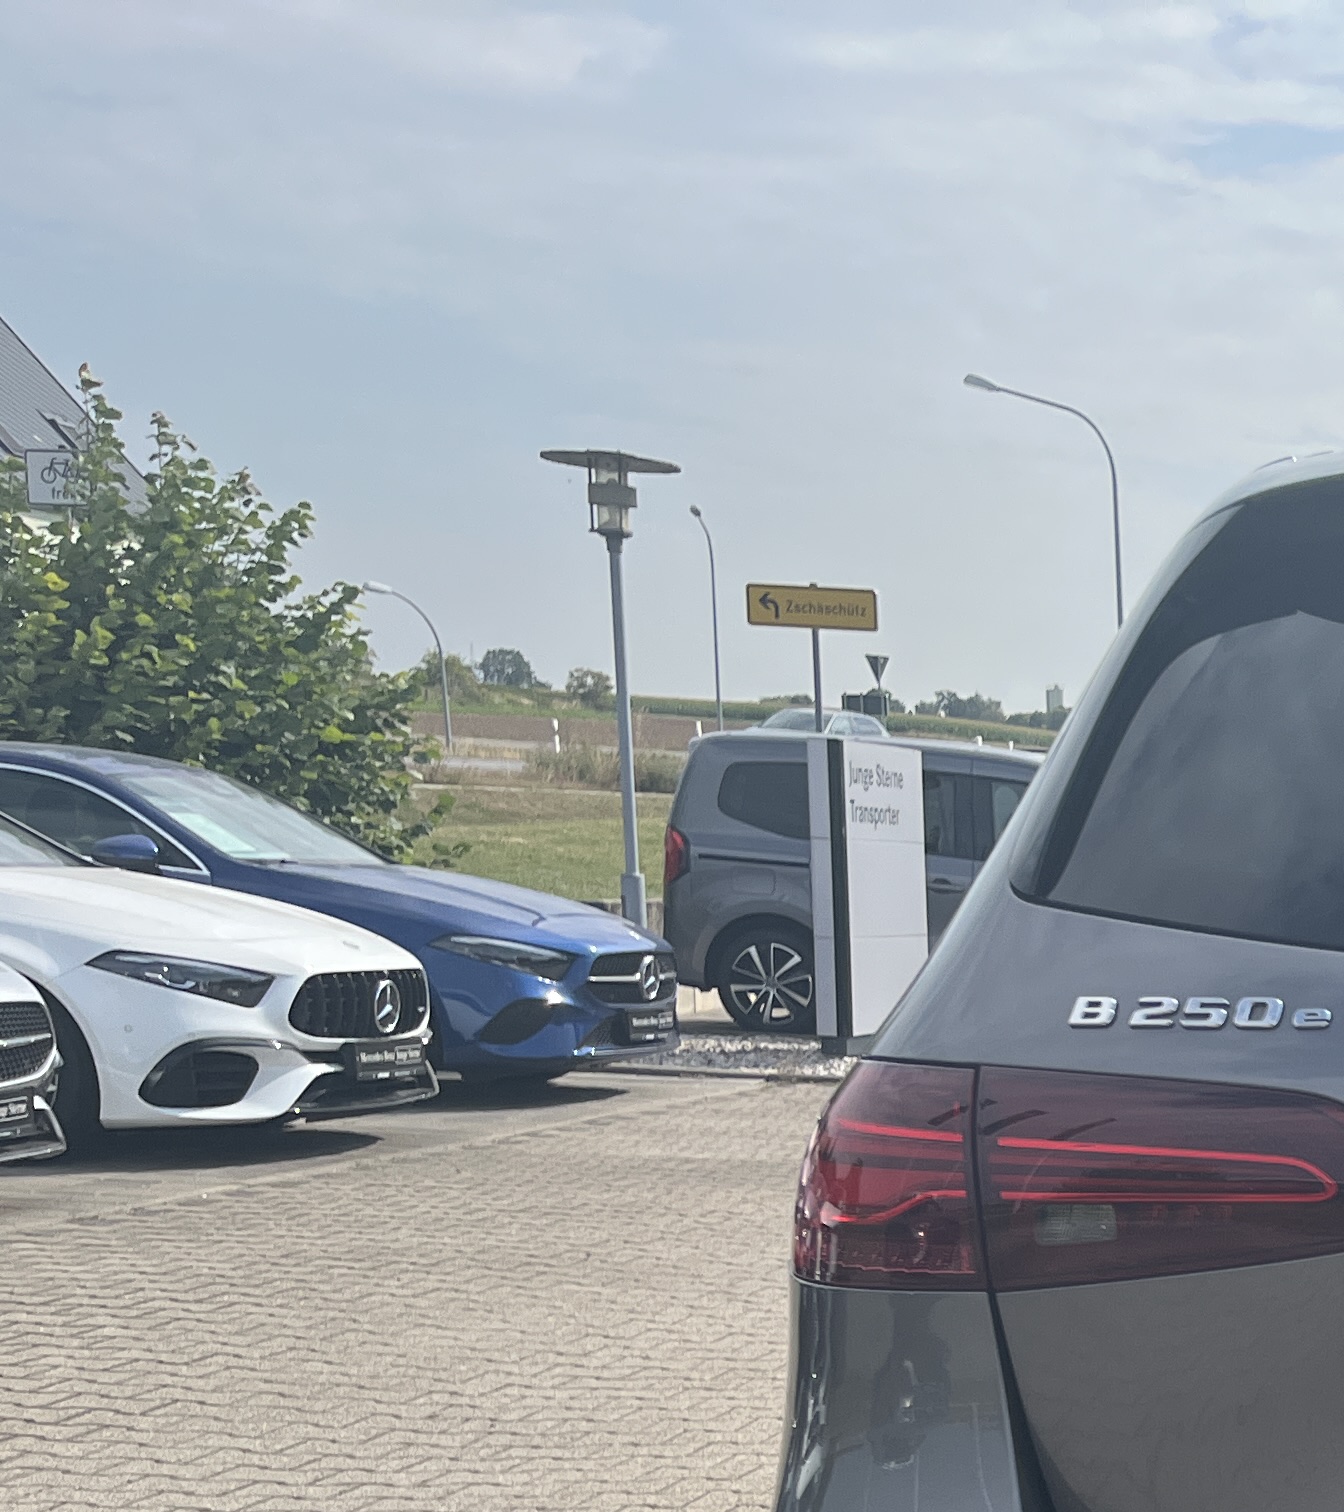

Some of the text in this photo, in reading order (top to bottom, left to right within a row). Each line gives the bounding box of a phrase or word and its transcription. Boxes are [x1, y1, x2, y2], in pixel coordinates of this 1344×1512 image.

[849, 760, 904, 792] Junge Sterne
[849, 799, 900, 831] Transporter
[1067, 996, 1119, 1029] B
